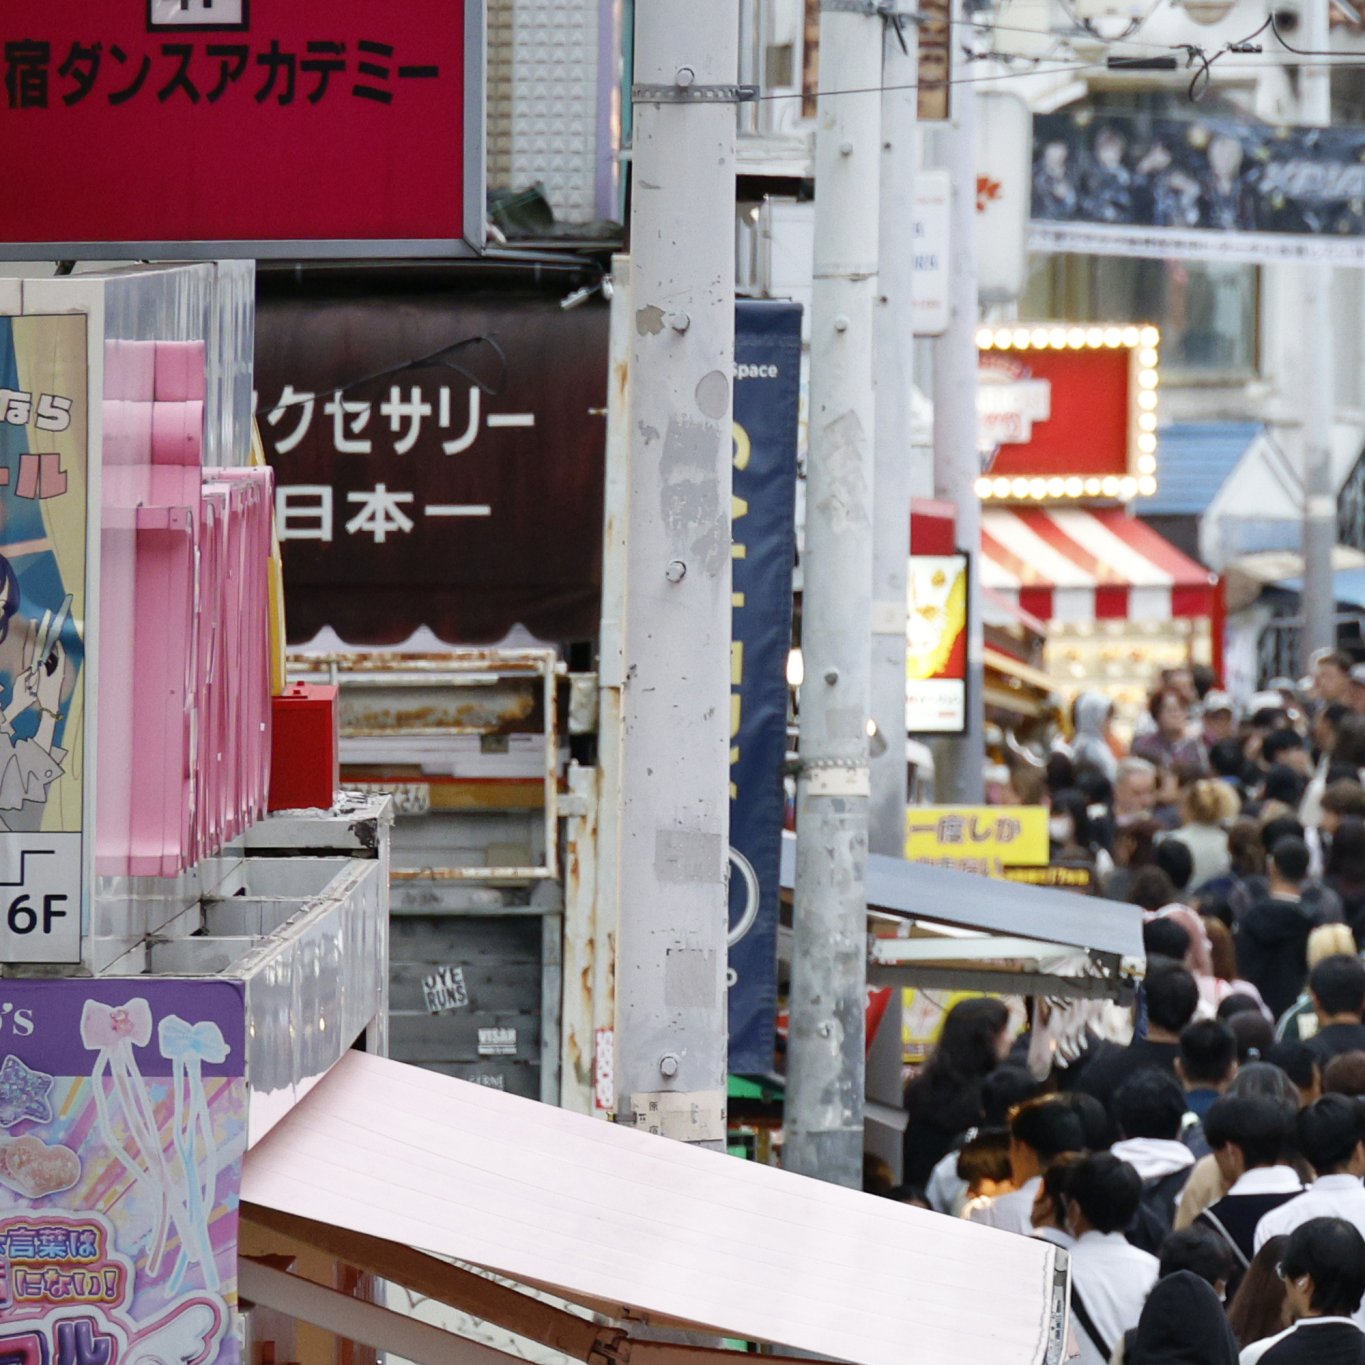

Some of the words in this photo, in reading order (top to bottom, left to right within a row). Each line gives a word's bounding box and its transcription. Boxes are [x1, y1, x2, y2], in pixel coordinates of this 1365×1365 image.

[260, 385, 535, 455] クセサリー
[276, 486, 492, 543] 日本一
[7, 893, 69, 936] 6F
[0, 1225, 98, 1260] 言葉は
